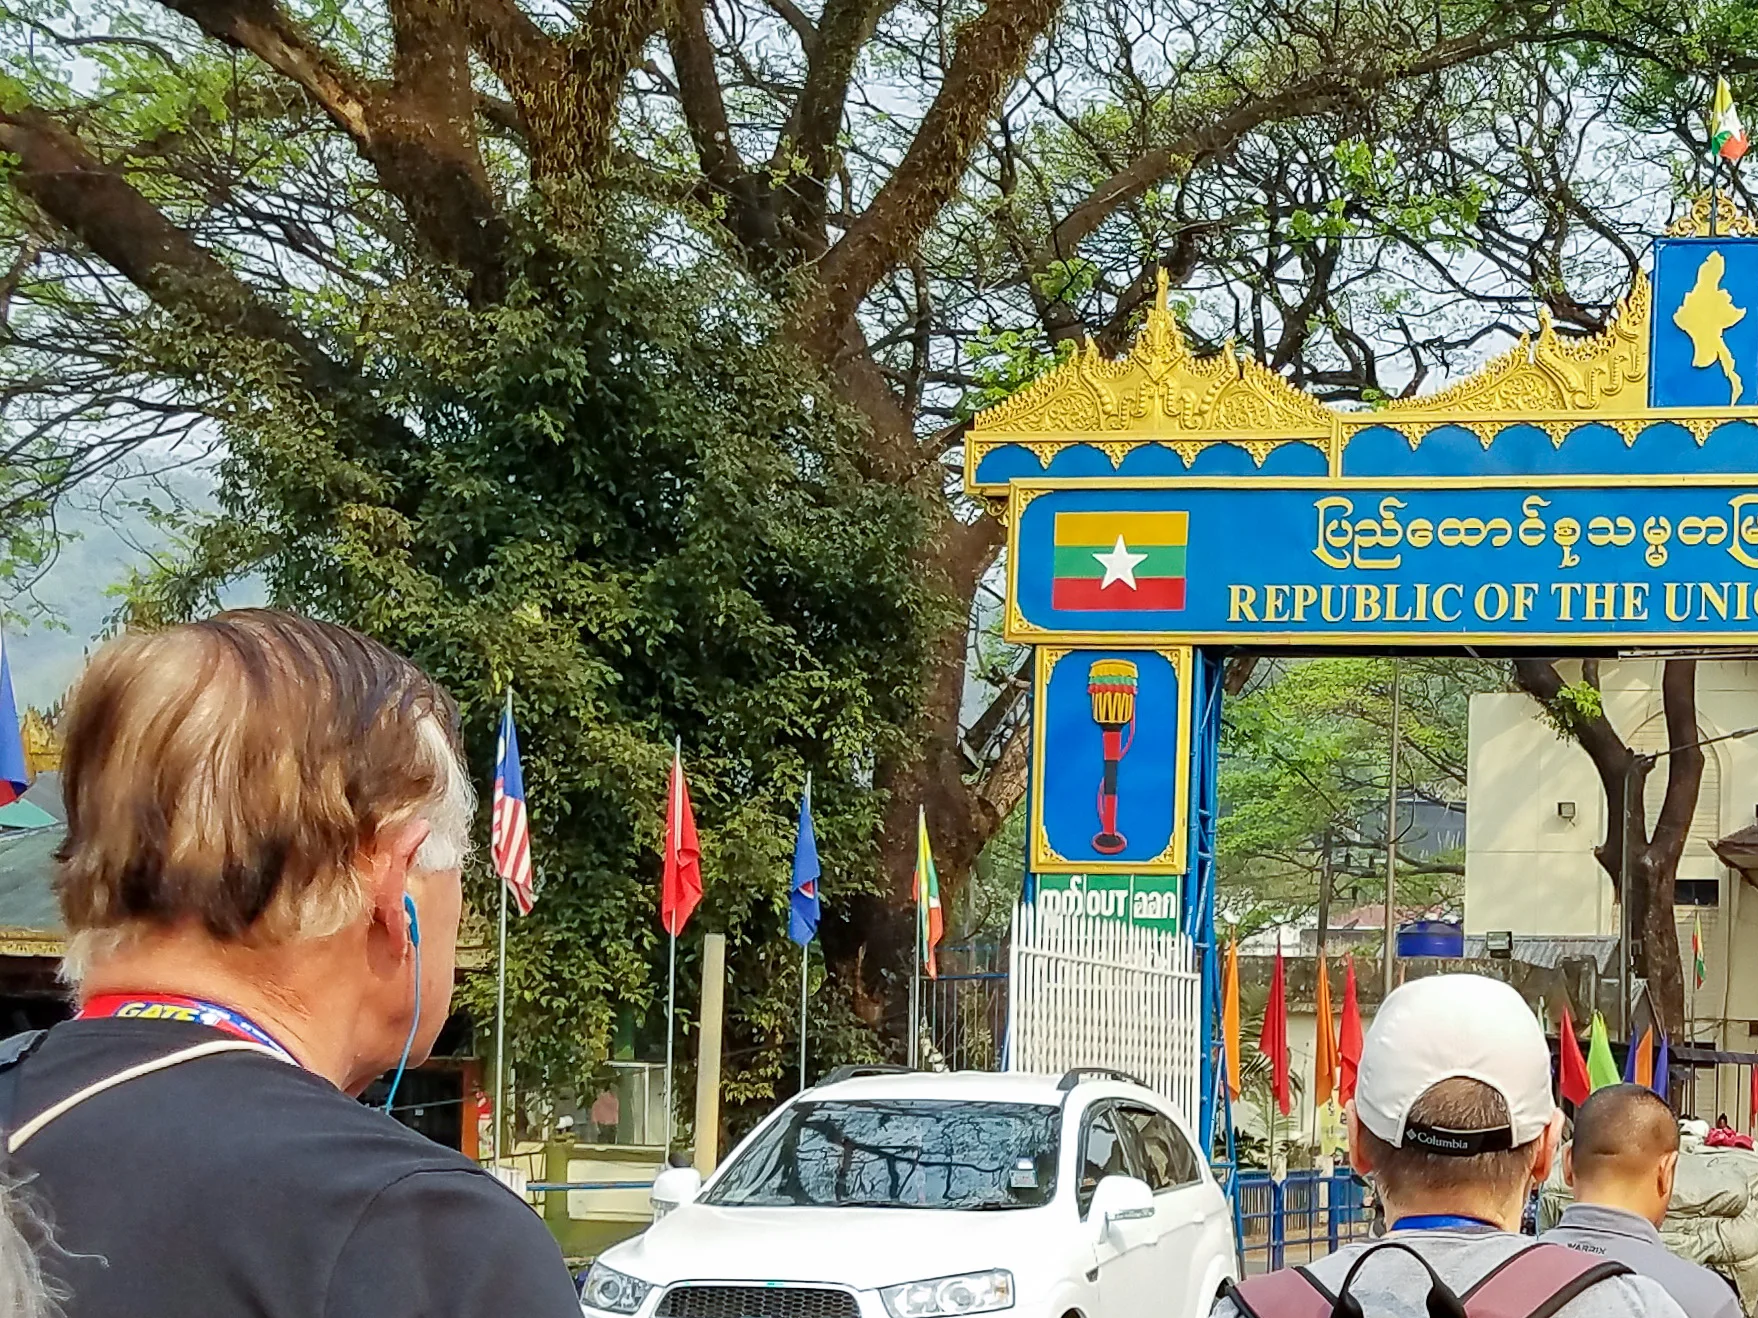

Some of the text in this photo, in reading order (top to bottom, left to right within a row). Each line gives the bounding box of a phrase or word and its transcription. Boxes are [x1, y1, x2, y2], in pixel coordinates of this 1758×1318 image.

[1227, 583, 1465, 622] REPUBLIC
[1474, 583, 1538, 622] OF
[1551, 583, 1650, 622] THE
[1086, 889, 1129, 918] OUT
[1133, 891, 1177, 919] ออก
[116, 1002, 200, 1022] GATE
[1417, 1132, 1468, 1149] Columbia
